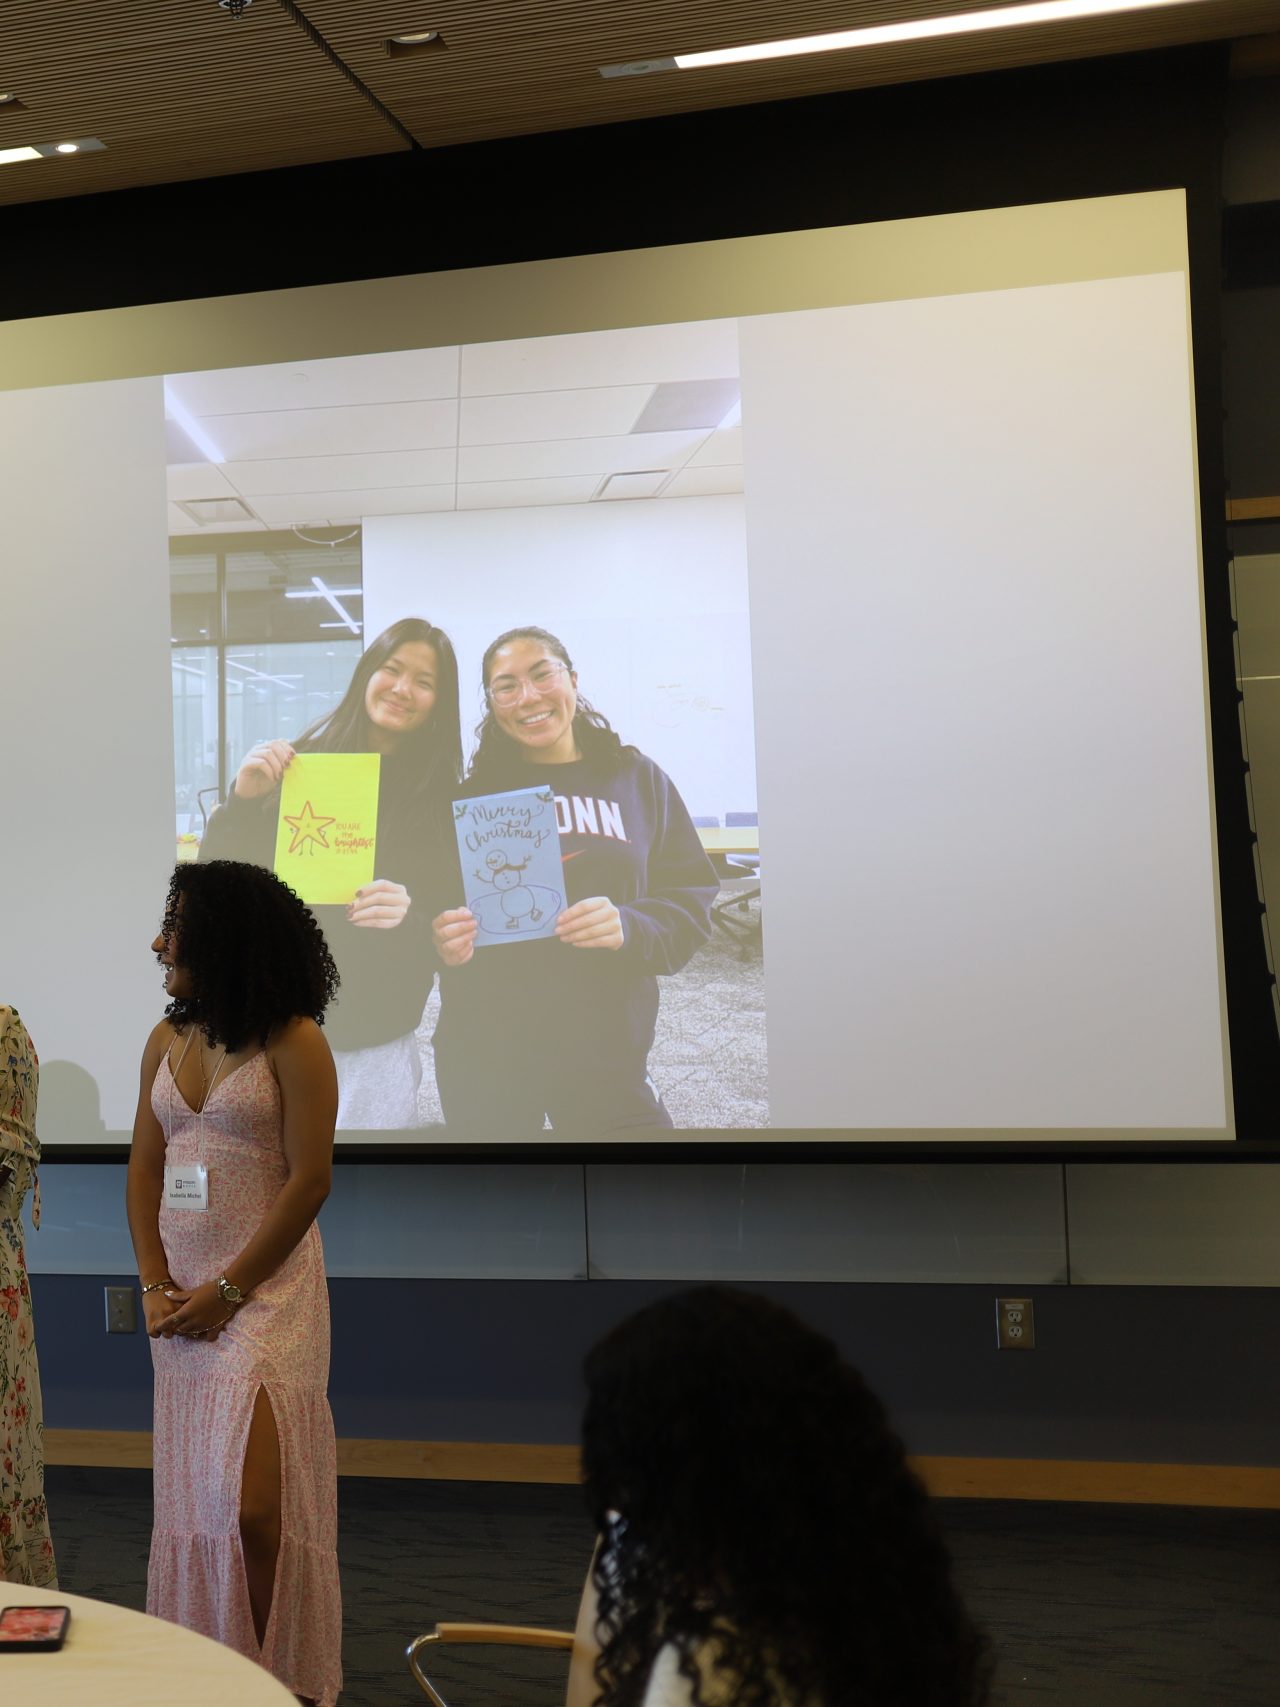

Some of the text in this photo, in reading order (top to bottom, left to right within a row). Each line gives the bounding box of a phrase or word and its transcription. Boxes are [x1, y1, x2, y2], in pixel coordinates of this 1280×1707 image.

[470, 804, 545, 826] Merry
[553, 795, 627, 842] ONN
[465, 819, 552, 852] Christmas
